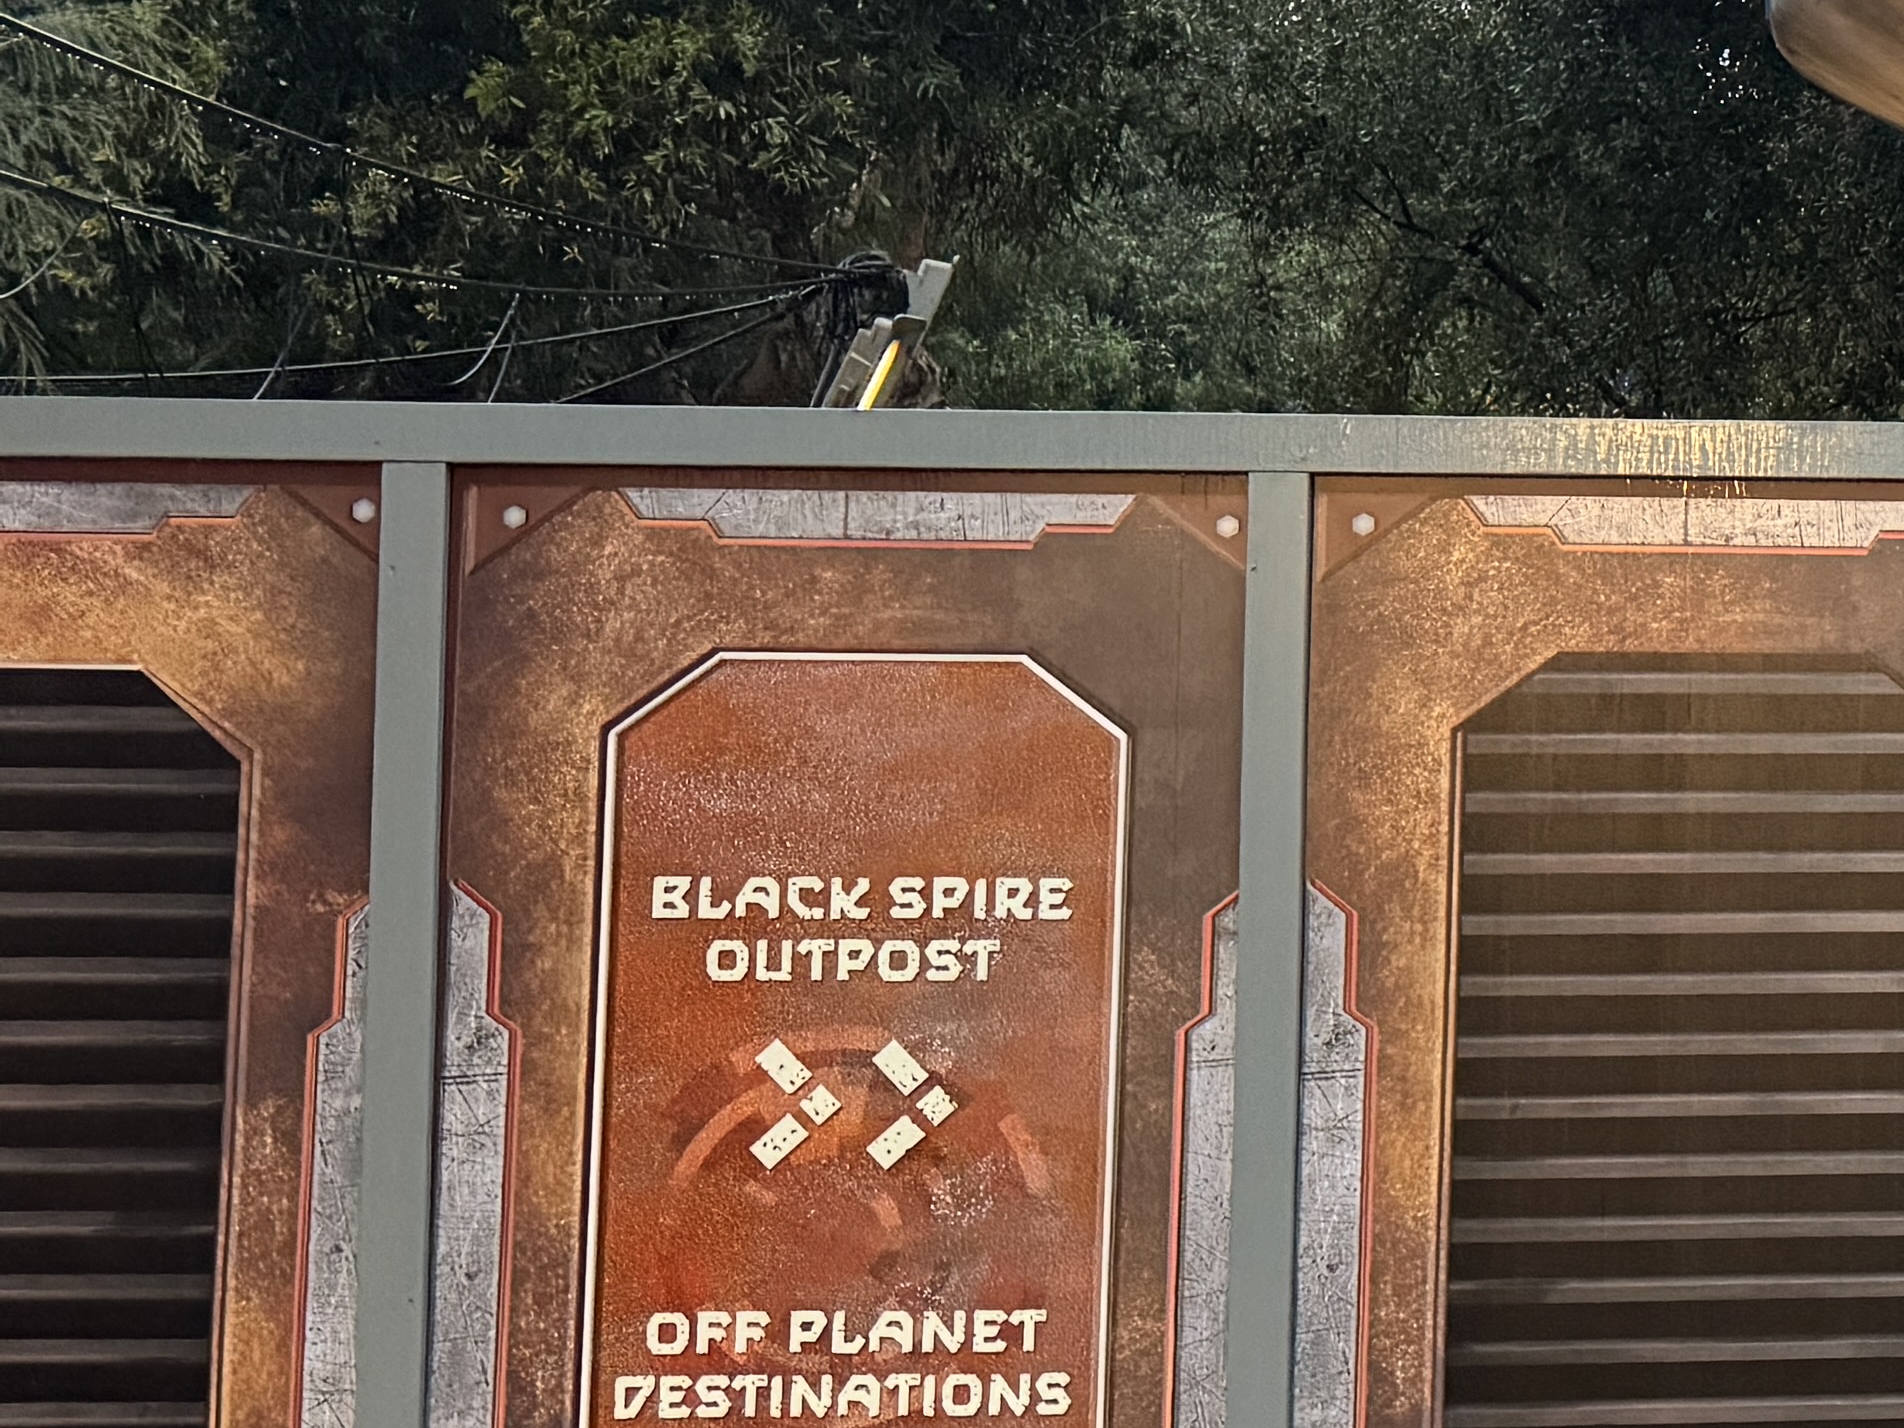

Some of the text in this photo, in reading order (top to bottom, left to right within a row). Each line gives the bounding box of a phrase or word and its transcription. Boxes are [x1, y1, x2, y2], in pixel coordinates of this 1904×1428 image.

[650, 874, 1075, 921] BLACK SPIRE
[705, 938, 1002, 982] OUTPOST
[645, 1308, 1048, 1355] OFF PLANET
[612, 1371, 1073, 1420] DESTINATIONS
